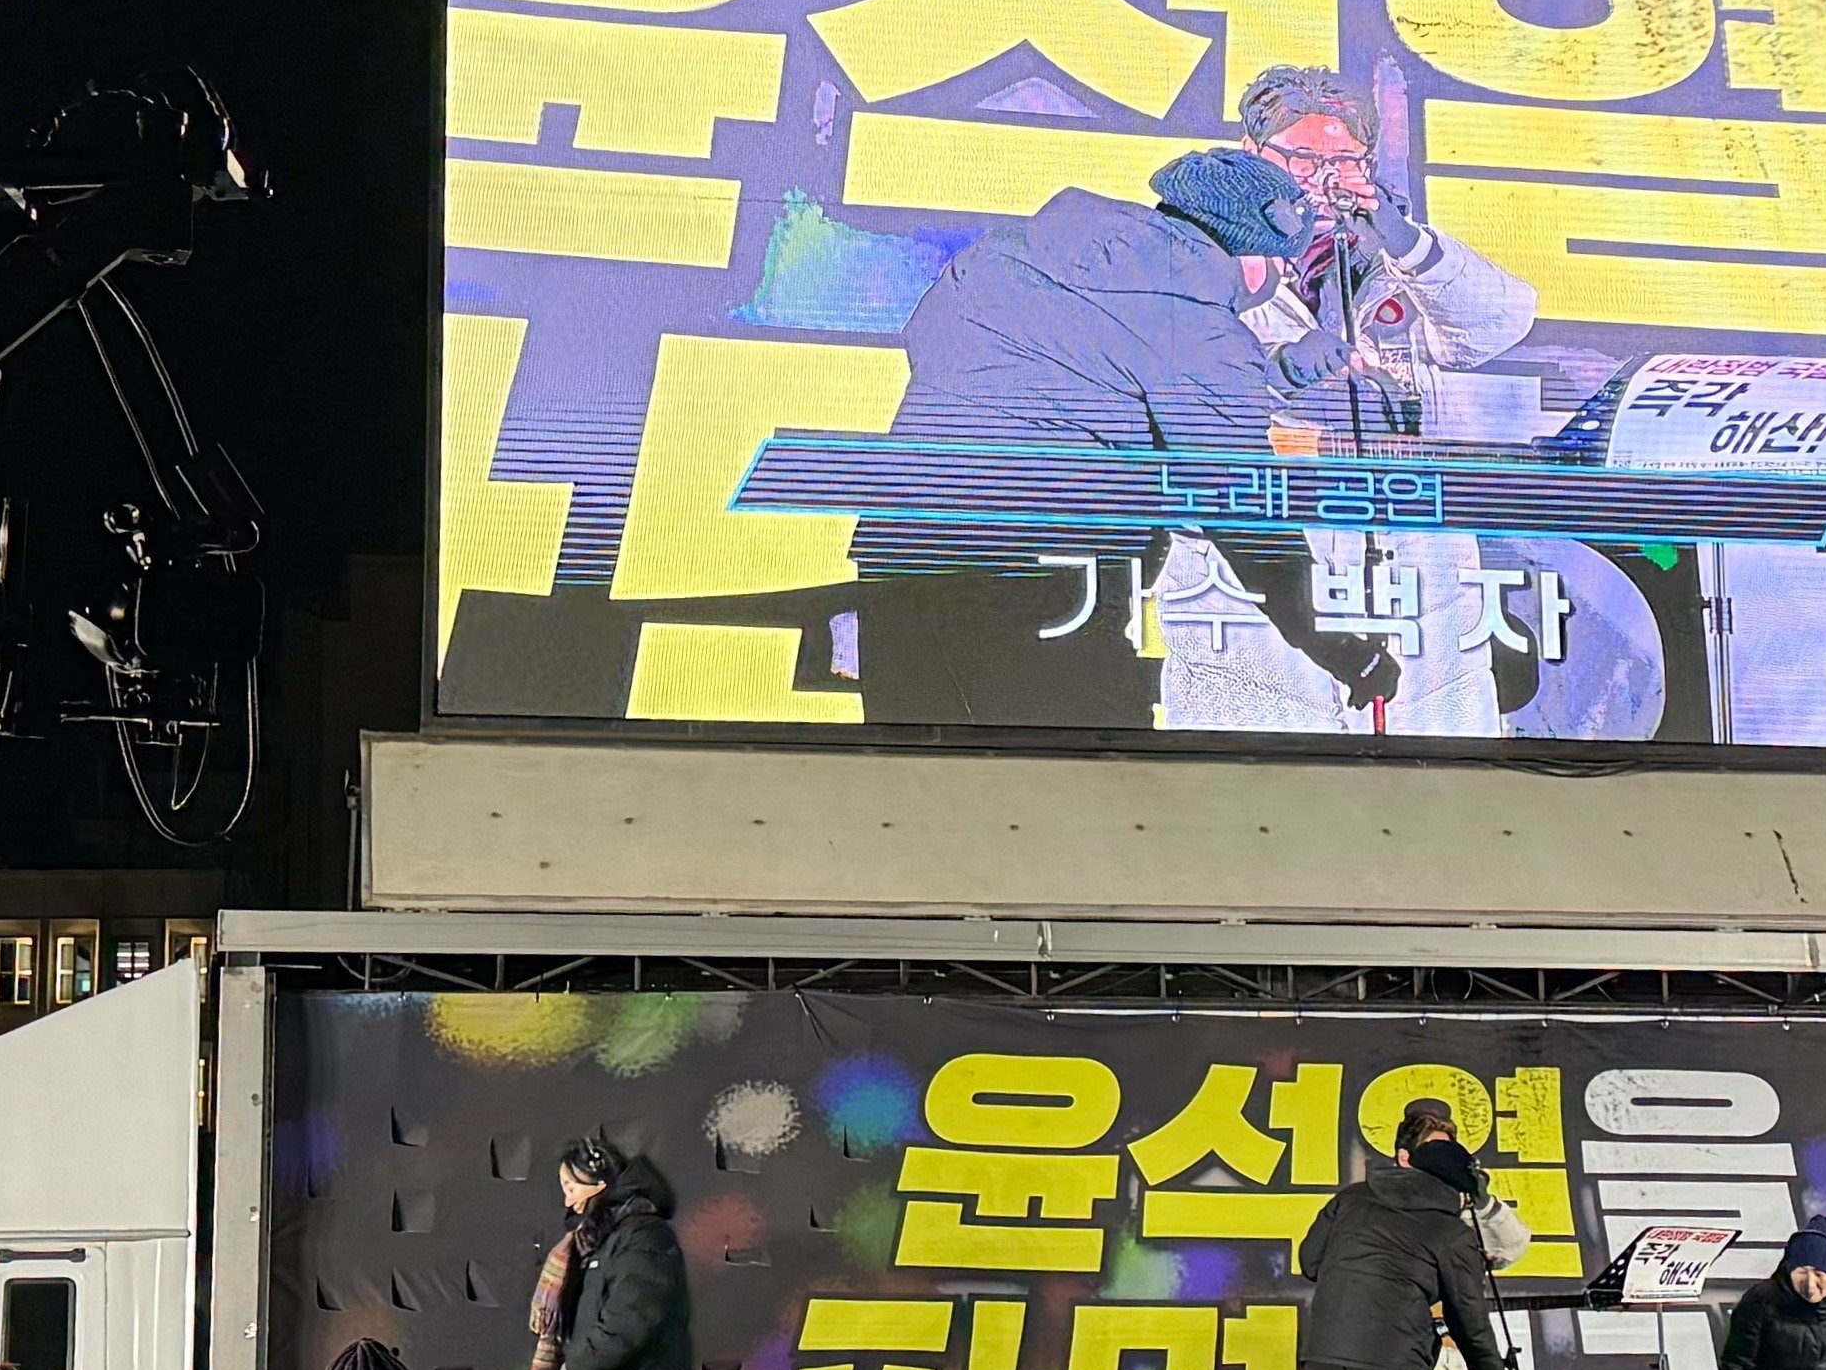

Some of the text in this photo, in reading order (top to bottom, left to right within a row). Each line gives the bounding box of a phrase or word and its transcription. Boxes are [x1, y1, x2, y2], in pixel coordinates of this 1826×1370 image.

[1627, 378, 1752, 418] 즉각
[1160, 464, 1445, 524] 노래 공연
[1038, 554, 1273, 652] 가수
[1634, 1242, 1681, 1266] 즉각
